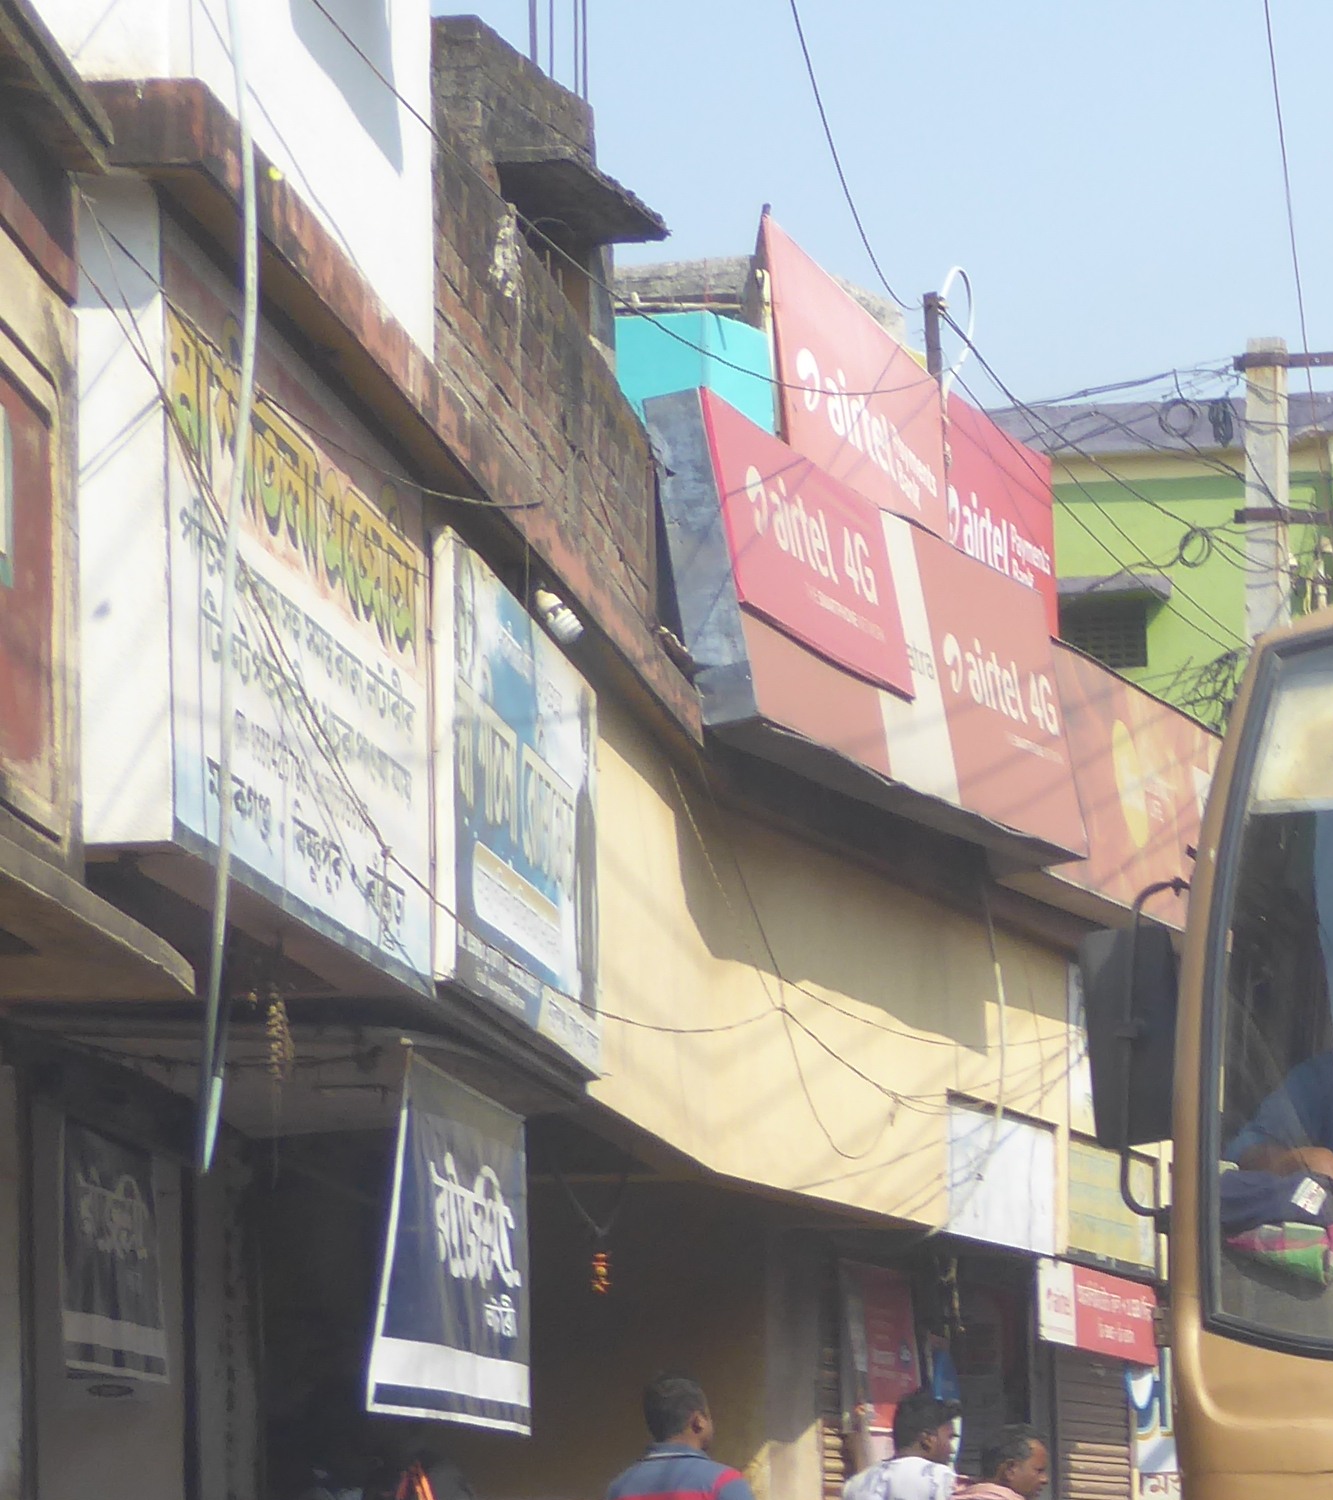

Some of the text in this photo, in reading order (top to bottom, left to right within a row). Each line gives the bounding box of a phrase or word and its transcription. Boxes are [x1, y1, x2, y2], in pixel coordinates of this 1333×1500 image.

[825, 369, 897, 482] airtel
[769, 476, 879, 606] airtel 4G
[962, 491, 1009, 576] airtel
[965, 638, 1061, 737] airtel 4G
